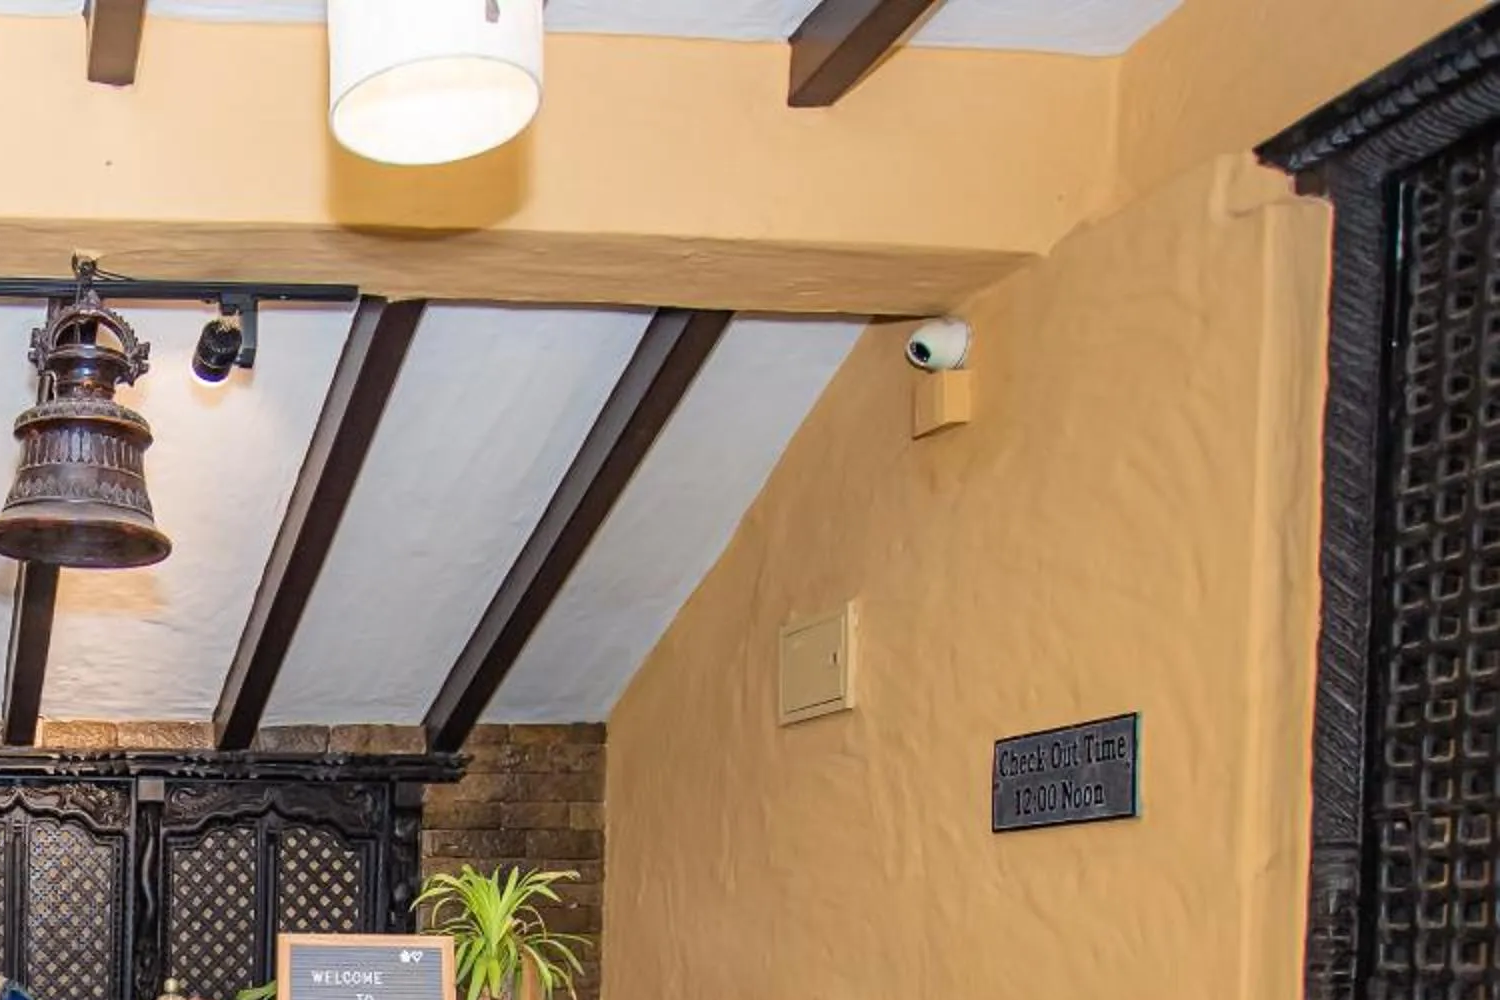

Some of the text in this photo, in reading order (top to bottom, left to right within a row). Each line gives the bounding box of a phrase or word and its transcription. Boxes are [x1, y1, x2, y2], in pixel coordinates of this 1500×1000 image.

[999, 733, 1127, 777] Check Out Time
[1015, 777, 1104, 816] 12:00 Noon
[311, 971, 384, 985] WELCOME
